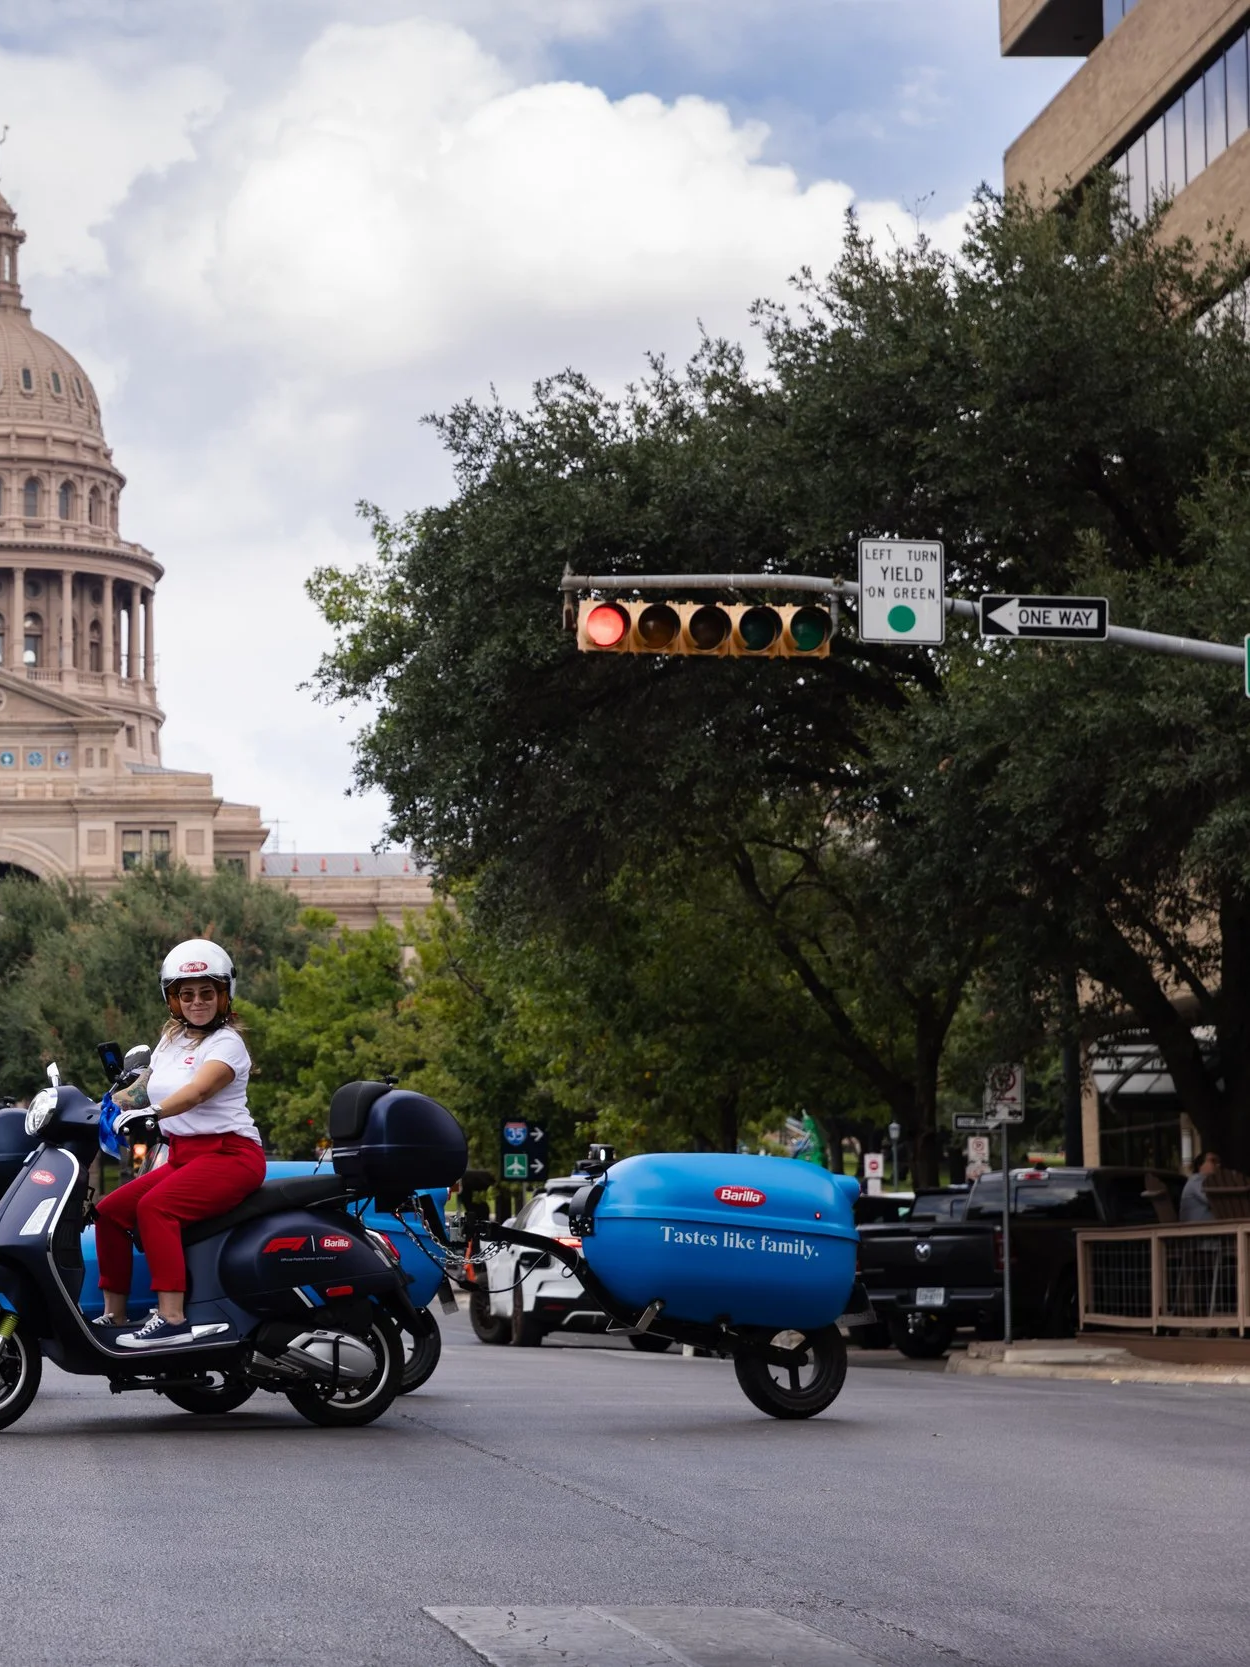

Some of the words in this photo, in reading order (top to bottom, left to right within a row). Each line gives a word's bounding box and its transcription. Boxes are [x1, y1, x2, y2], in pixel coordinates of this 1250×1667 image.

[865, 548, 892, 561] LEFT
[907, 549, 937, 562] TURN
[880, 566, 923, 582] YIELD
[868, 586, 885, 598] ON
[893, 587, 935, 600] GREEN
[1018, 609, 1052, 625] ONE
[1059, 610, 1092, 626] WAY
[508, 1128, 523, 1140] 35
[720, 1189, 760, 1203] Barilla
[323, 1238, 349, 1248] Barilla
[660, 1225, 718, 1247] Tastes
[723, 1231, 756, 1250] like
[760, 1235, 819, 1260] family.
